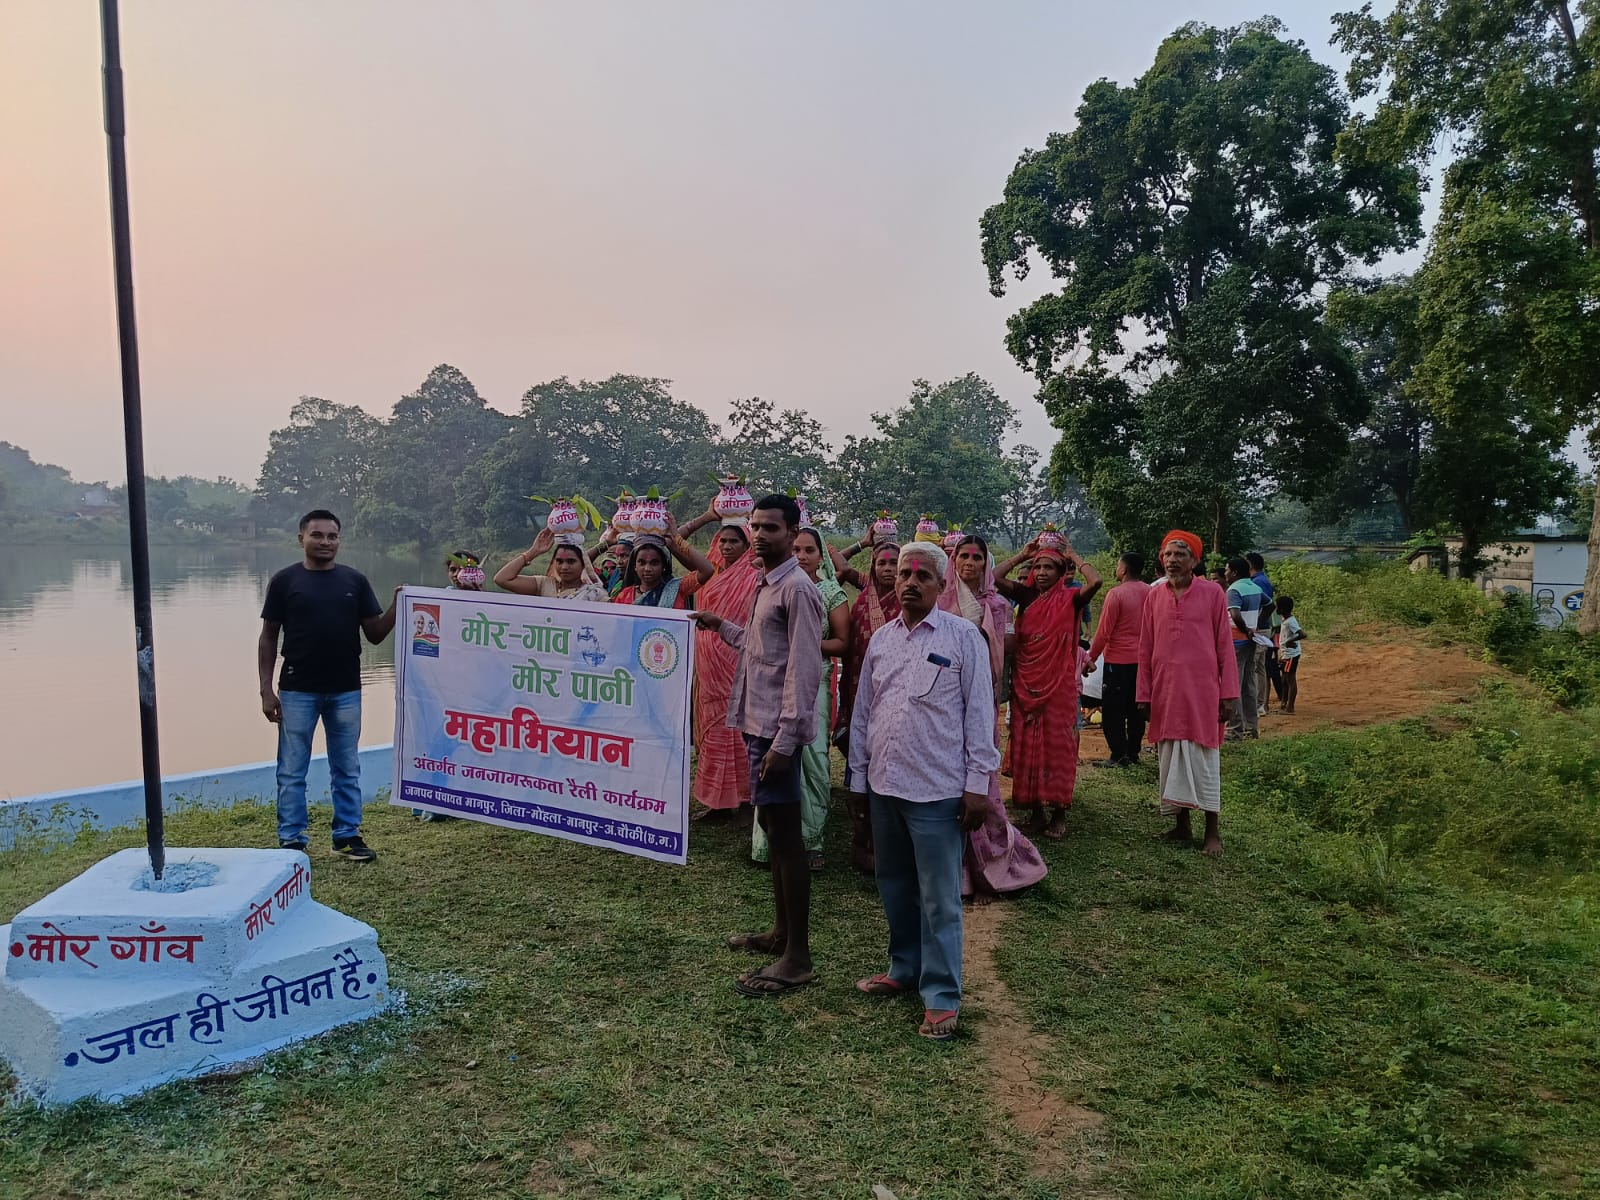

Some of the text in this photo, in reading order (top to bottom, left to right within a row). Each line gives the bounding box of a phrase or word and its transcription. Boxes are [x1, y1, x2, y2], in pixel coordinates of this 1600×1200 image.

[461, 612, 572, 655] मोर-गांव
[512, 659, 636, 706] मोर पानी
[444, 707, 635, 768] महाभियान
[405, 785, 433, 799] जनपद
[435, 788, 463, 806] पंचायत
[464, 797, 498, 814] मानपुर,
[414, 752, 667, 815] अंतर्गत जनजागरूकता रैली कार्यक्रम
[244, 863, 305, 941] मोर पानी
[27, 920, 204, 969] मोर गाँव
[80, 947, 370, 1065] जल ही जीवन है
